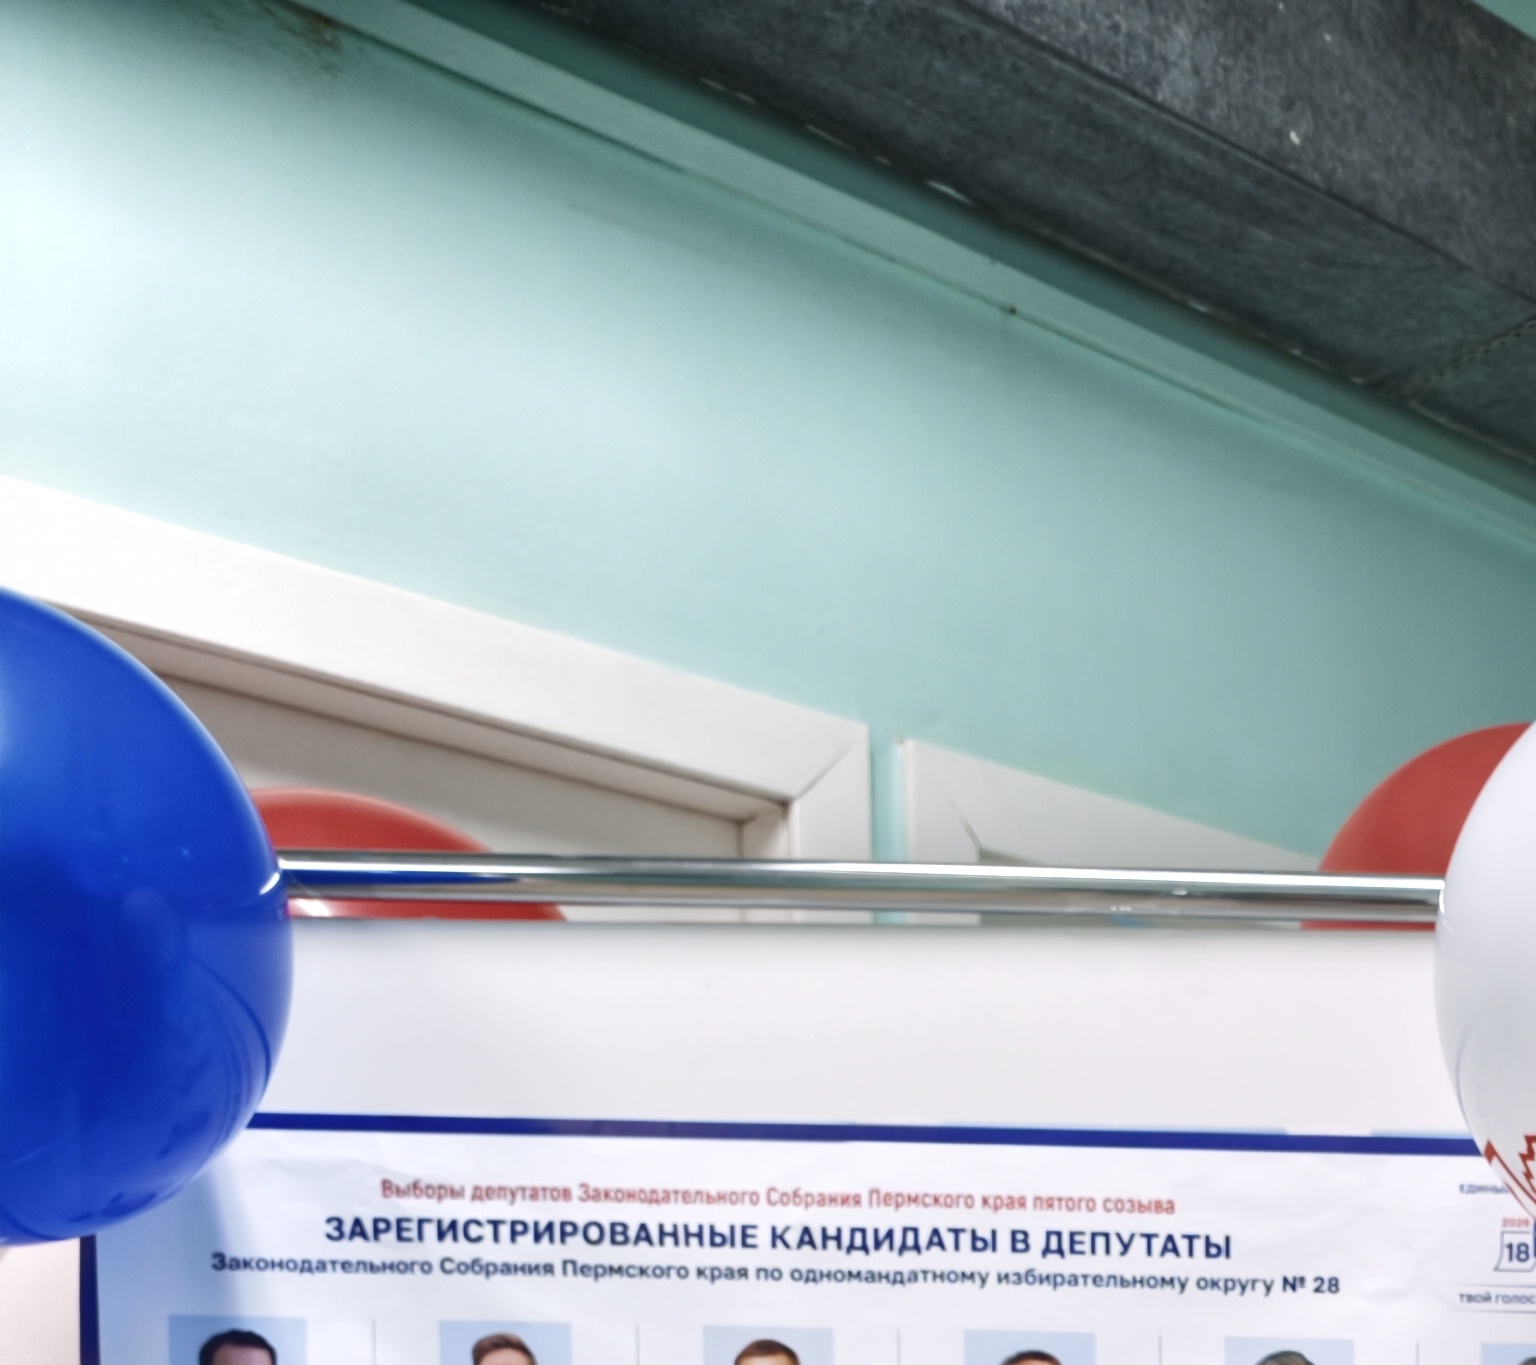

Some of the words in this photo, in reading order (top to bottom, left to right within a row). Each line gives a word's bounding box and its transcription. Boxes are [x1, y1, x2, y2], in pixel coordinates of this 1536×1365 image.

[380, 1179, 465, 1203] Выборы
[470, 1184, 573, 1206] депутатов
[577, 1182, 760, 1206] Законодательного
[766, 1186, 862, 1210] Собрания
[868, 1188, 975, 1211] Пермского
[981, 1195, 1027, 1214] края
[1033, 1195, 1097, 1213] пятого
[1102, 1197, 1175, 1215] созыва
[1459, 1184, 1509, 1193] ЕДИНЫ
[325, 1217, 758, 1249] ЗАРЕГИСТРИРОВАННЫЕ
[771, 1225, 997, 1257] КАНДИДАТЫ
[1010, 1230, 1031, 1253] В
[1041, 1230, 1231, 1259] ДЕПУТАТЫ
[1505, 1242, 1530, 1262] 18
[211, 1252, 433, 1278] Законодательного
[439, 1257, 555, 1279] Собрания
[561, 1259, 689, 1282] Пермского
[696, 1266, 749, 1284] края
[755, 1267, 783, 1282] по
[789, 1268, 989, 1289] одномандатному
[997, 1268, 1189, 1294] избирательному
[1196, 1277, 1274, 1296] округу
[1282, 1276, 1306, 1292] №
[1313, 1276, 1340, 1294] 28
[1459, 1294, 1492, 1304] ТВОЙ
[1495, 1294, 1535, 1304] ГОЛОС
